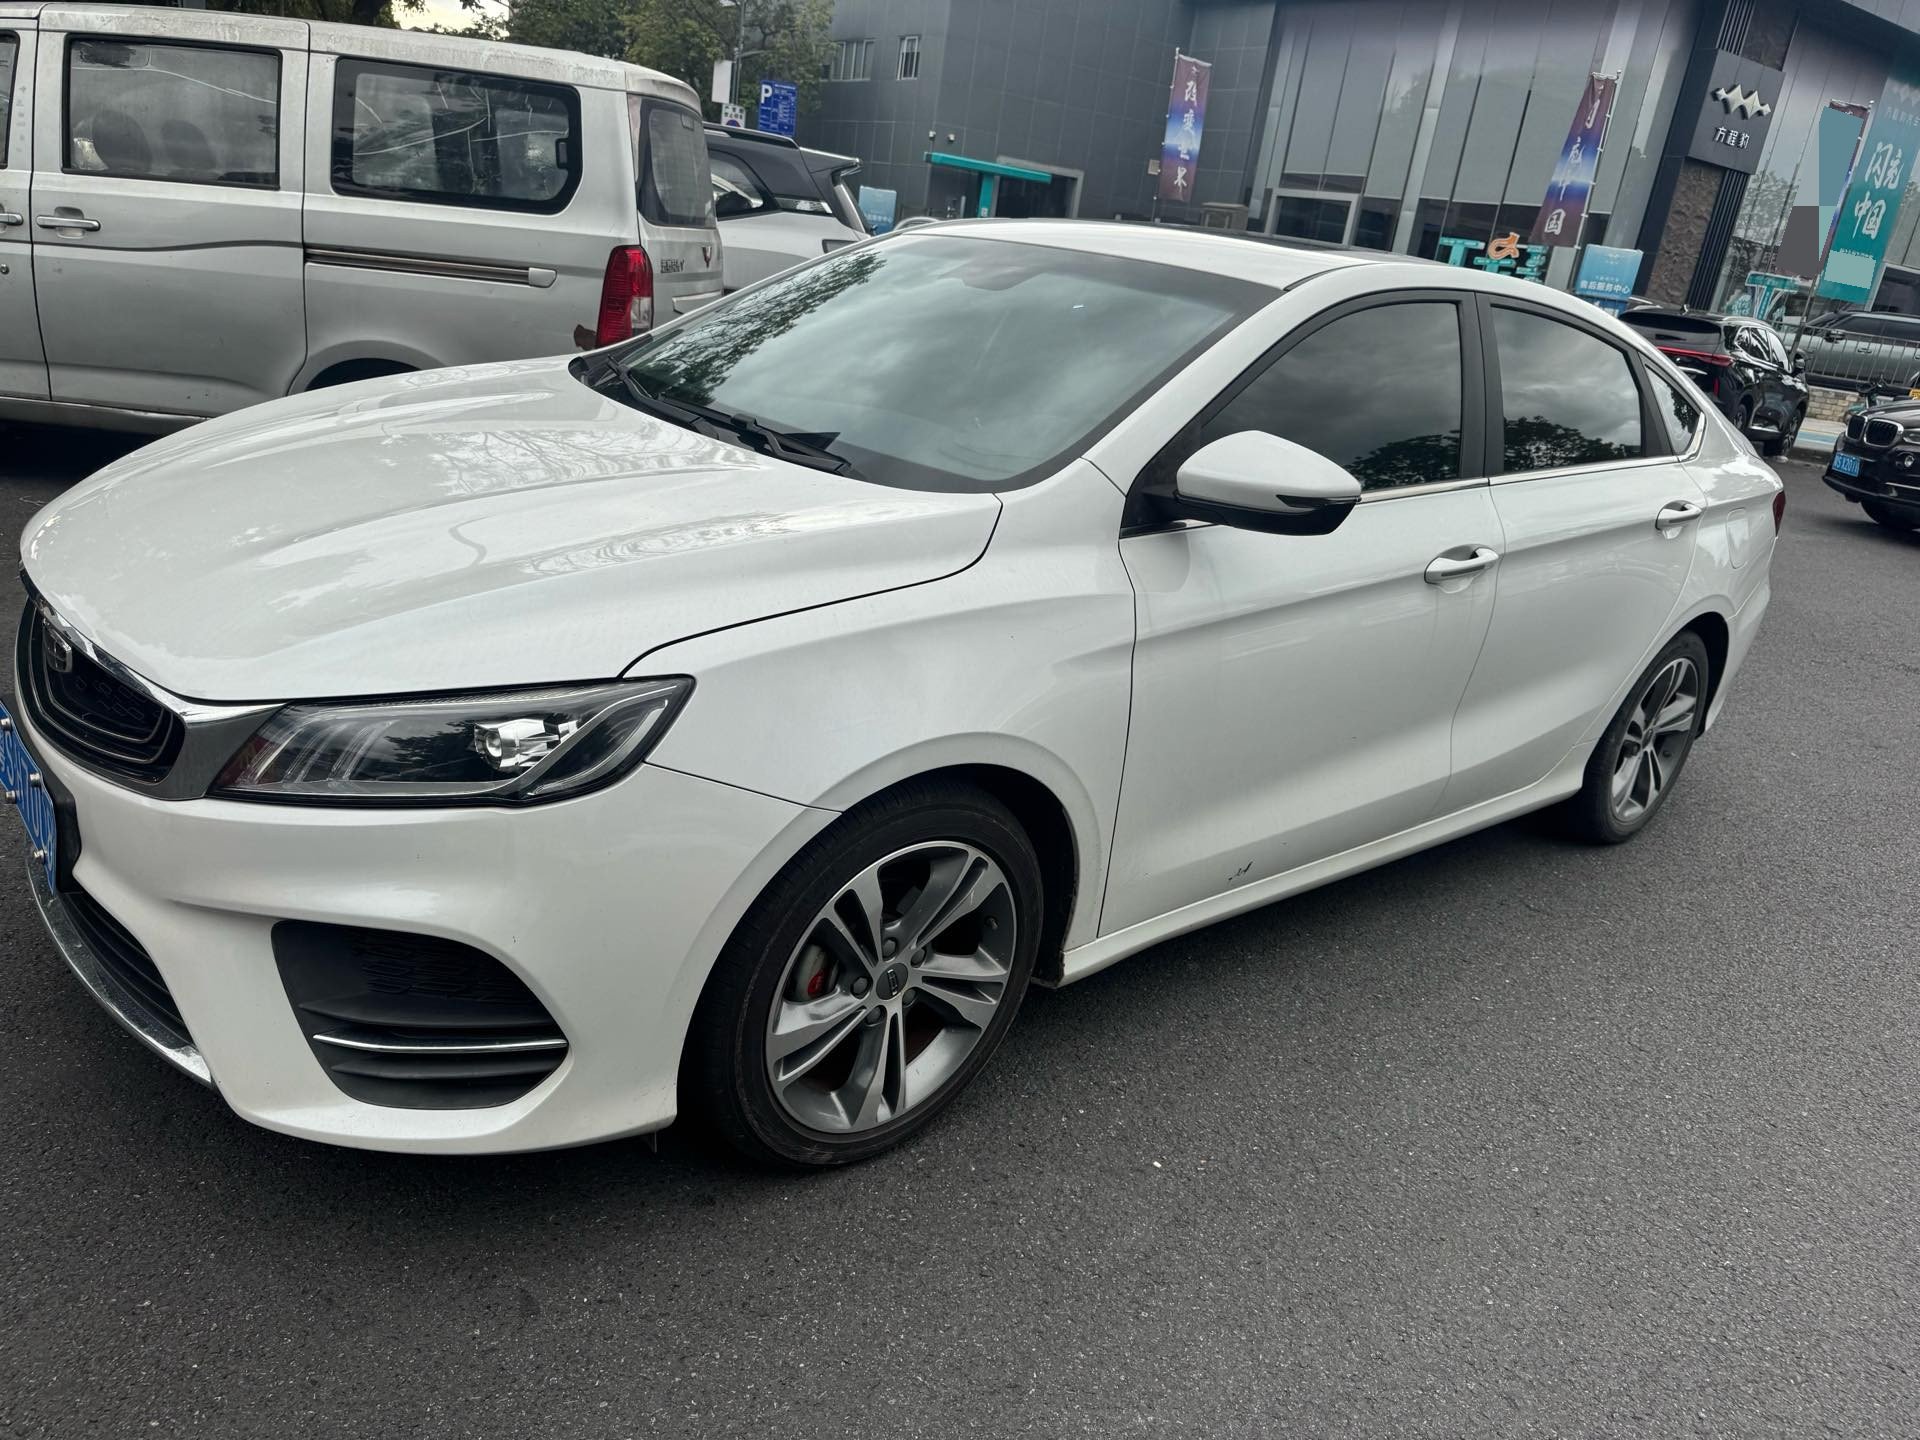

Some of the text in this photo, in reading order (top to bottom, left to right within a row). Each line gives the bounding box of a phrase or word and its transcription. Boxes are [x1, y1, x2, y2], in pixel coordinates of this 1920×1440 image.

[761, 84, 773, 104] P
[1715, 126, 1750, 149] 方程豹
[1864, 142, 1904, 190] 闪充
[1852, 190, 1887, 240] 中国
[1580, 279, 1631, 295] 售后服务中心
